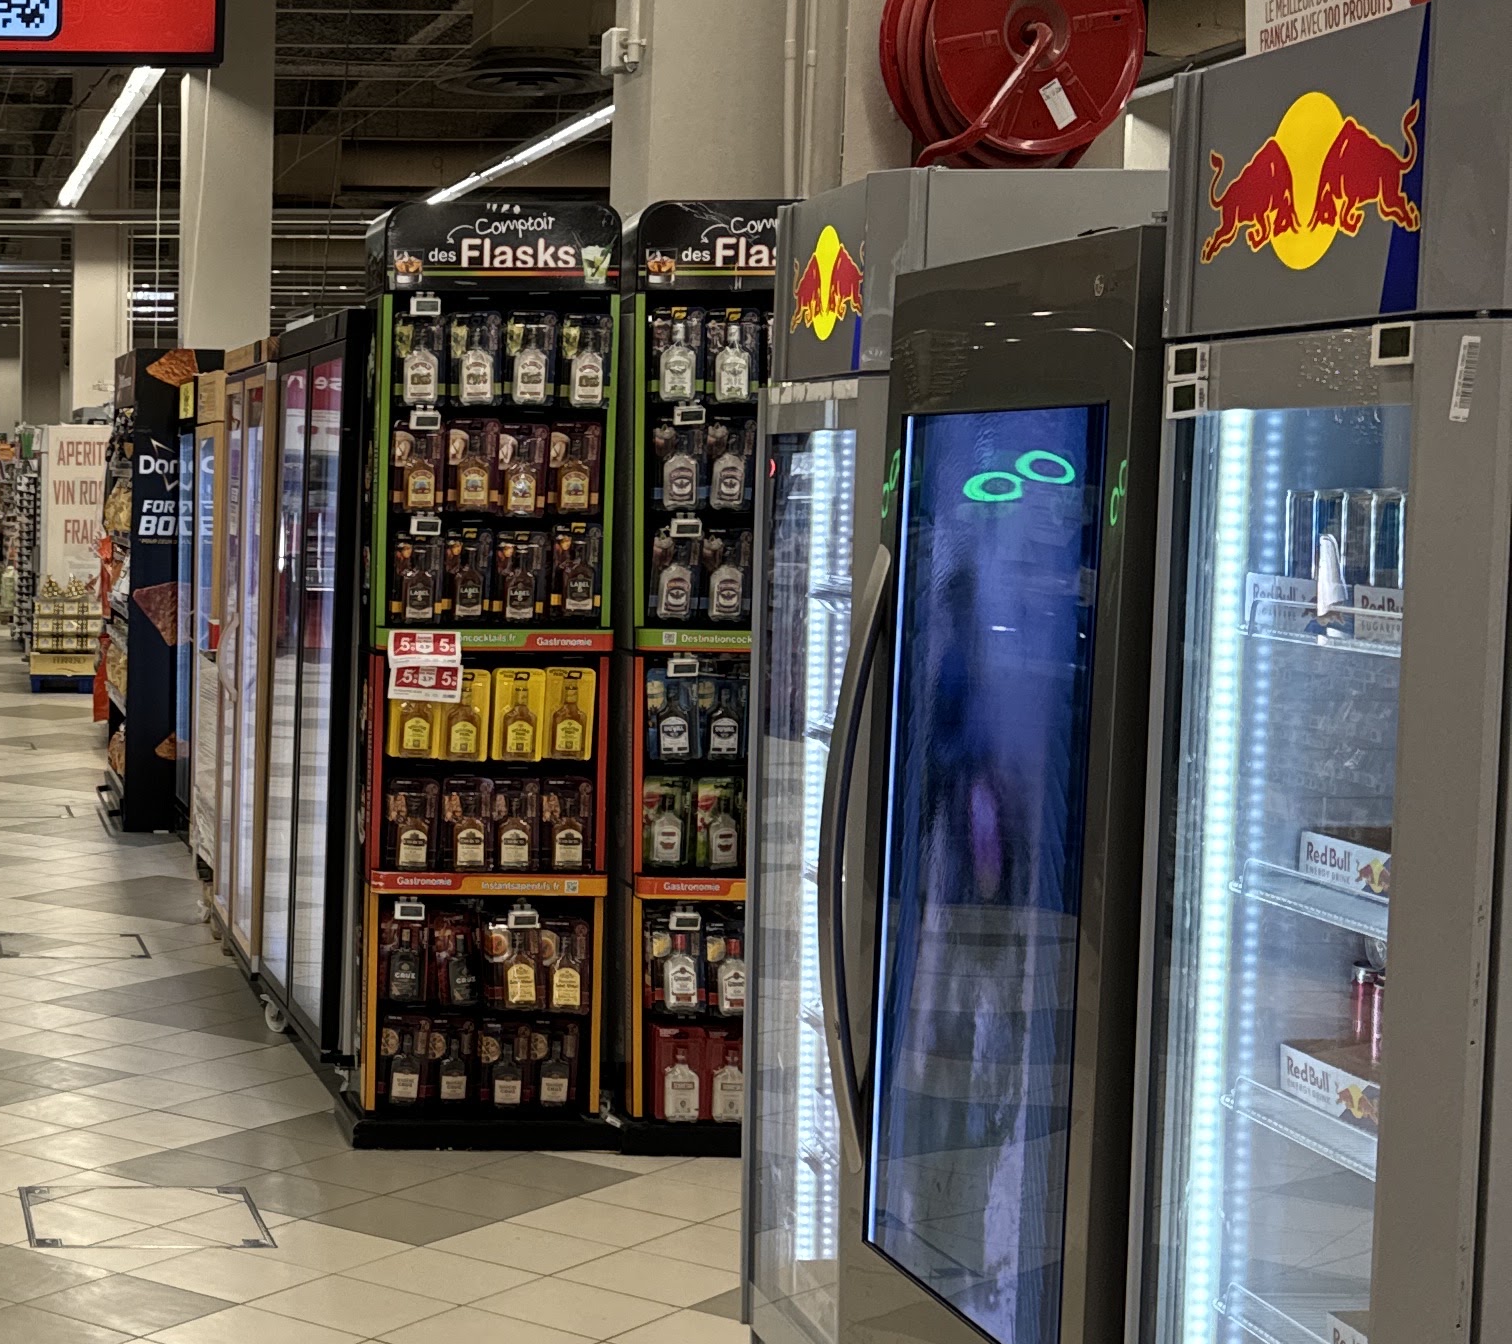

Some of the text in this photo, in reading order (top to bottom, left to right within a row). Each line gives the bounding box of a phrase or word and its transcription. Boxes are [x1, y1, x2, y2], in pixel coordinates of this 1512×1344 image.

[1264, 0, 1275, 24] LE
[1259, 17, 1299, 53] FRANÇAIS
[1300, 9, 1323, 39] AVEC
[1323, 4, 1341, 31] 100
[474, 214, 556, 239] Comptoir
[428, 237, 577, 269] des Flasks
[681, 246, 711, 263] des
[53, 480, 76, 506] VIN
[142, 499, 176, 514] FOR
[409, 589, 430, 597] LABEL
[510, 589, 530, 597] LABEL
[536, 636, 593, 648] Gastronomie
[1306, 841, 1351, 873] Red Bull
[396, 876, 453, 888] Gastronomie
[663, 881, 721, 893] Gastronomie
[1286, 1055, 1330, 1094] Red Bull
